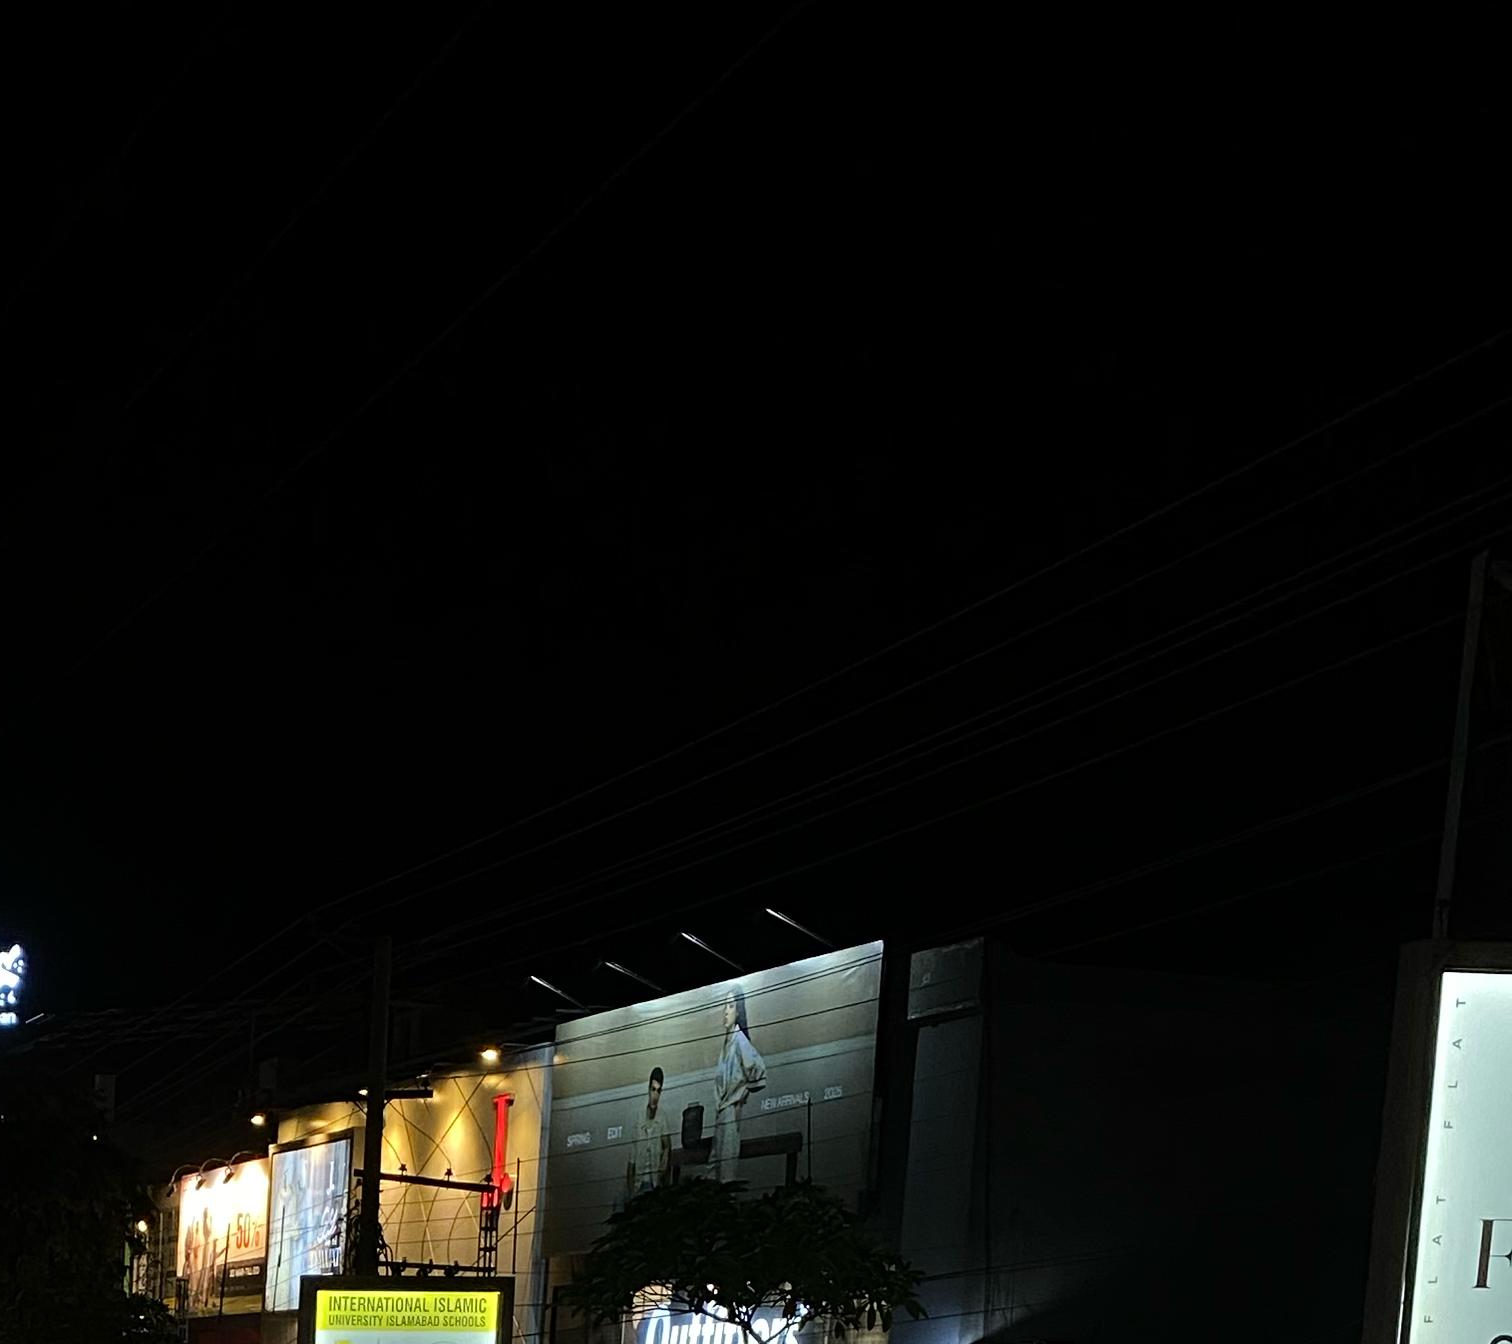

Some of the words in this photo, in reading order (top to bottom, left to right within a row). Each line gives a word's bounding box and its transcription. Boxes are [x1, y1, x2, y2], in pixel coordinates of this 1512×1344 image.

[329, 1296, 429, 1312] INTERNATIONAL
[434, 1297, 486, 1313] ISLAMIC
[329, 1315, 383, 1326] UNIVERSITY
[387, 1315, 439, 1327] ISLAMABAD
[443, 1316, 486, 1327] SCHOOLS
